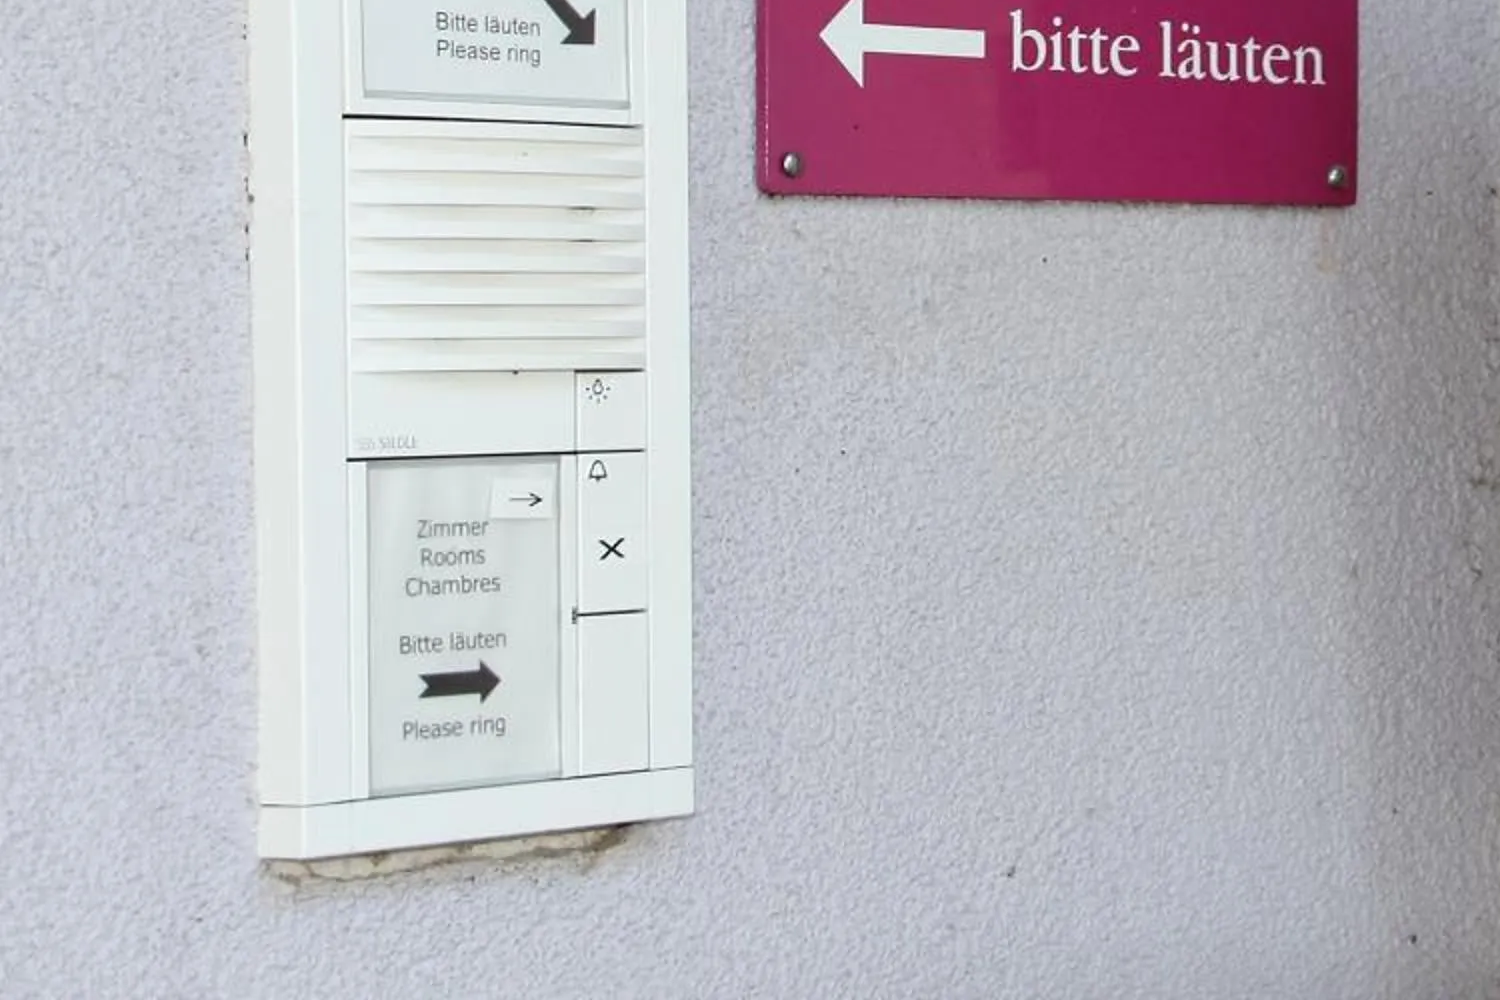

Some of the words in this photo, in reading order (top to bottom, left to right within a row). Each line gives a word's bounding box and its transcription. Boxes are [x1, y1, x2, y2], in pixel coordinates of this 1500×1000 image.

[435, 11, 479, 33] Bitte
[484, 15, 541, 37] läuten
[436, 38, 501, 61] Please
[507, 44, 541, 68] ring
[1009, 8, 1140, 76] bitte
[1159, 20, 1326, 85] läuten
[416, 518, 490, 540] Zimmer
[420, 547, 486, 568] Rooms
[405, 574, 501, 598] Chambres
[399, 635, 444, 655] Bitte
[449, 630, 507, 652] läuten
[402, 720, 464, 741] Please
[470, 715, 507, 738] ring
